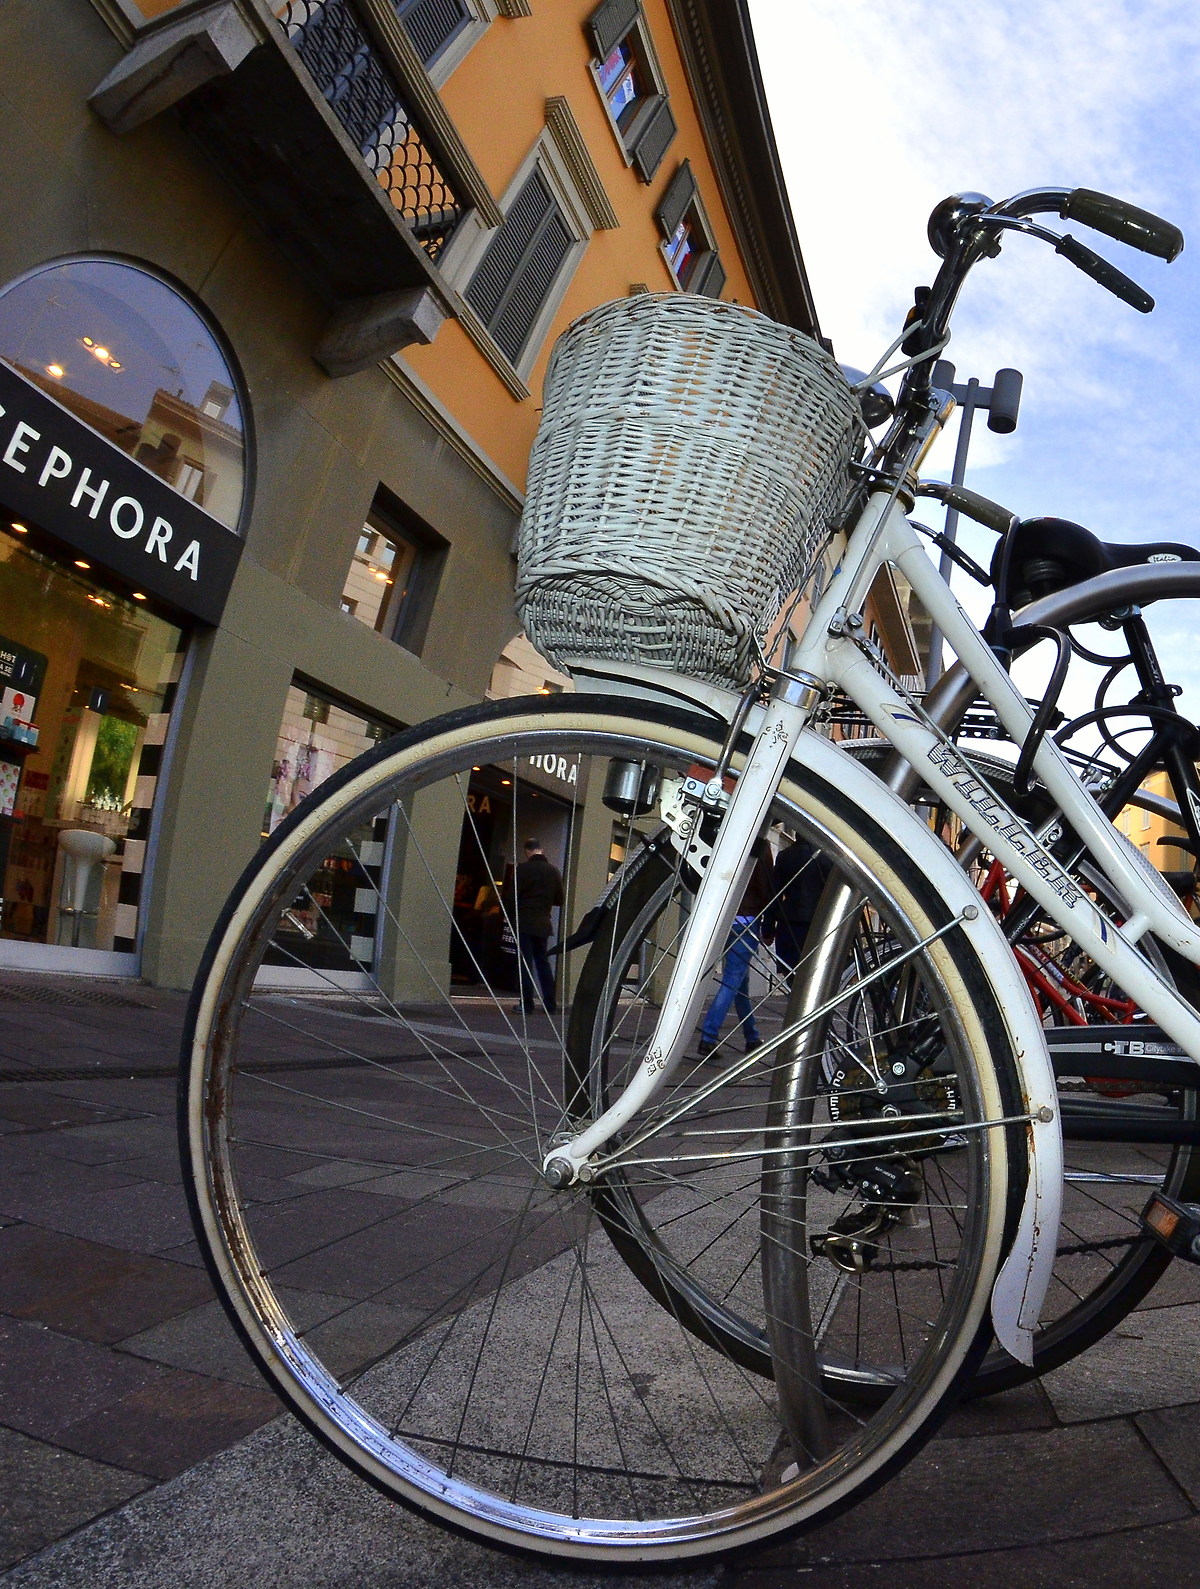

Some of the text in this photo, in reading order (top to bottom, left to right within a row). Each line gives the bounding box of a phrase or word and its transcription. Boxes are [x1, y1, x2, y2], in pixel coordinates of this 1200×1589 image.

[0, 404, 200, 581] EPHORA
[529, 753, 577, 787] HORA
[829, 1070, 846, 1122] HIMNO
